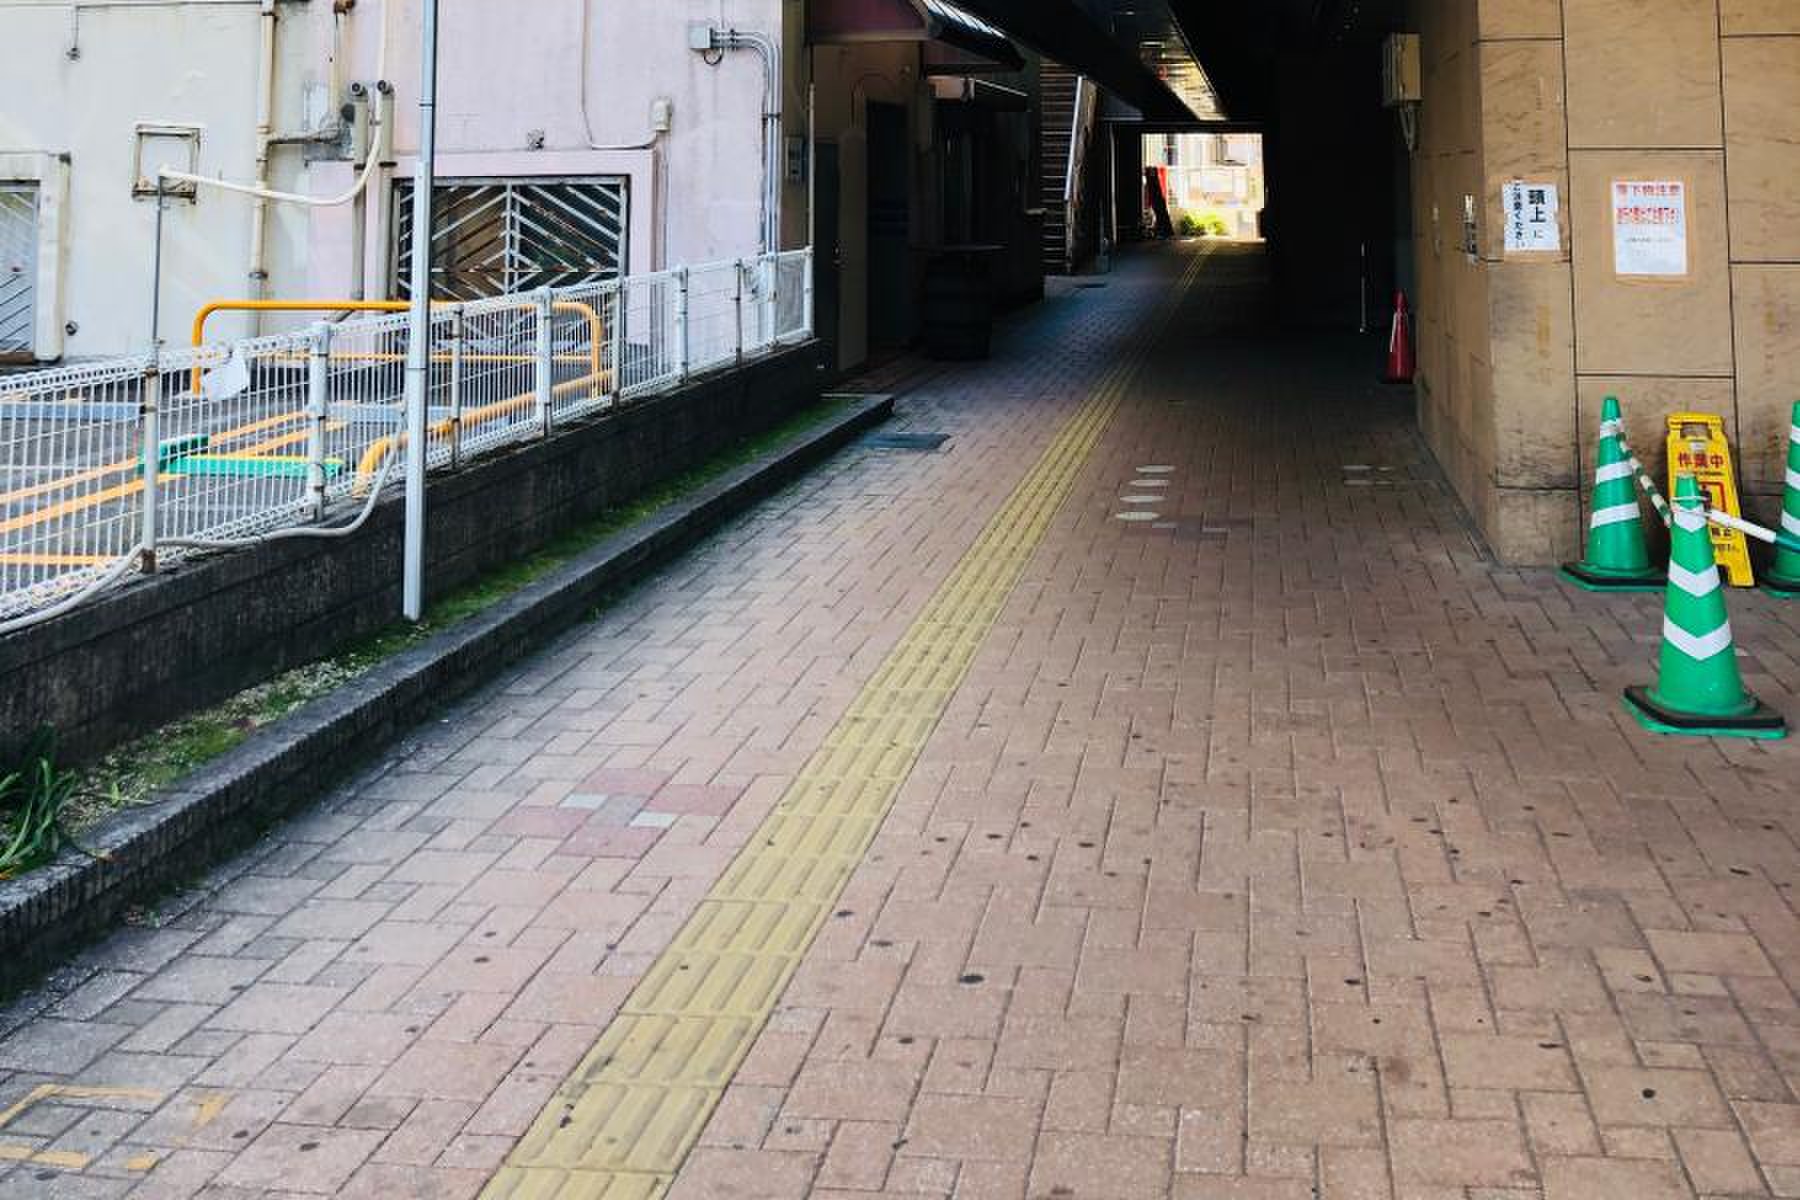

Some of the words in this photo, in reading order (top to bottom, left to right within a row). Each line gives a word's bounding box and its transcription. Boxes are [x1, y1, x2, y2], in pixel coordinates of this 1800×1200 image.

[1527, 189, 1546, 239] 頭上に
[1678, 452, 1724, 469] 作業中
